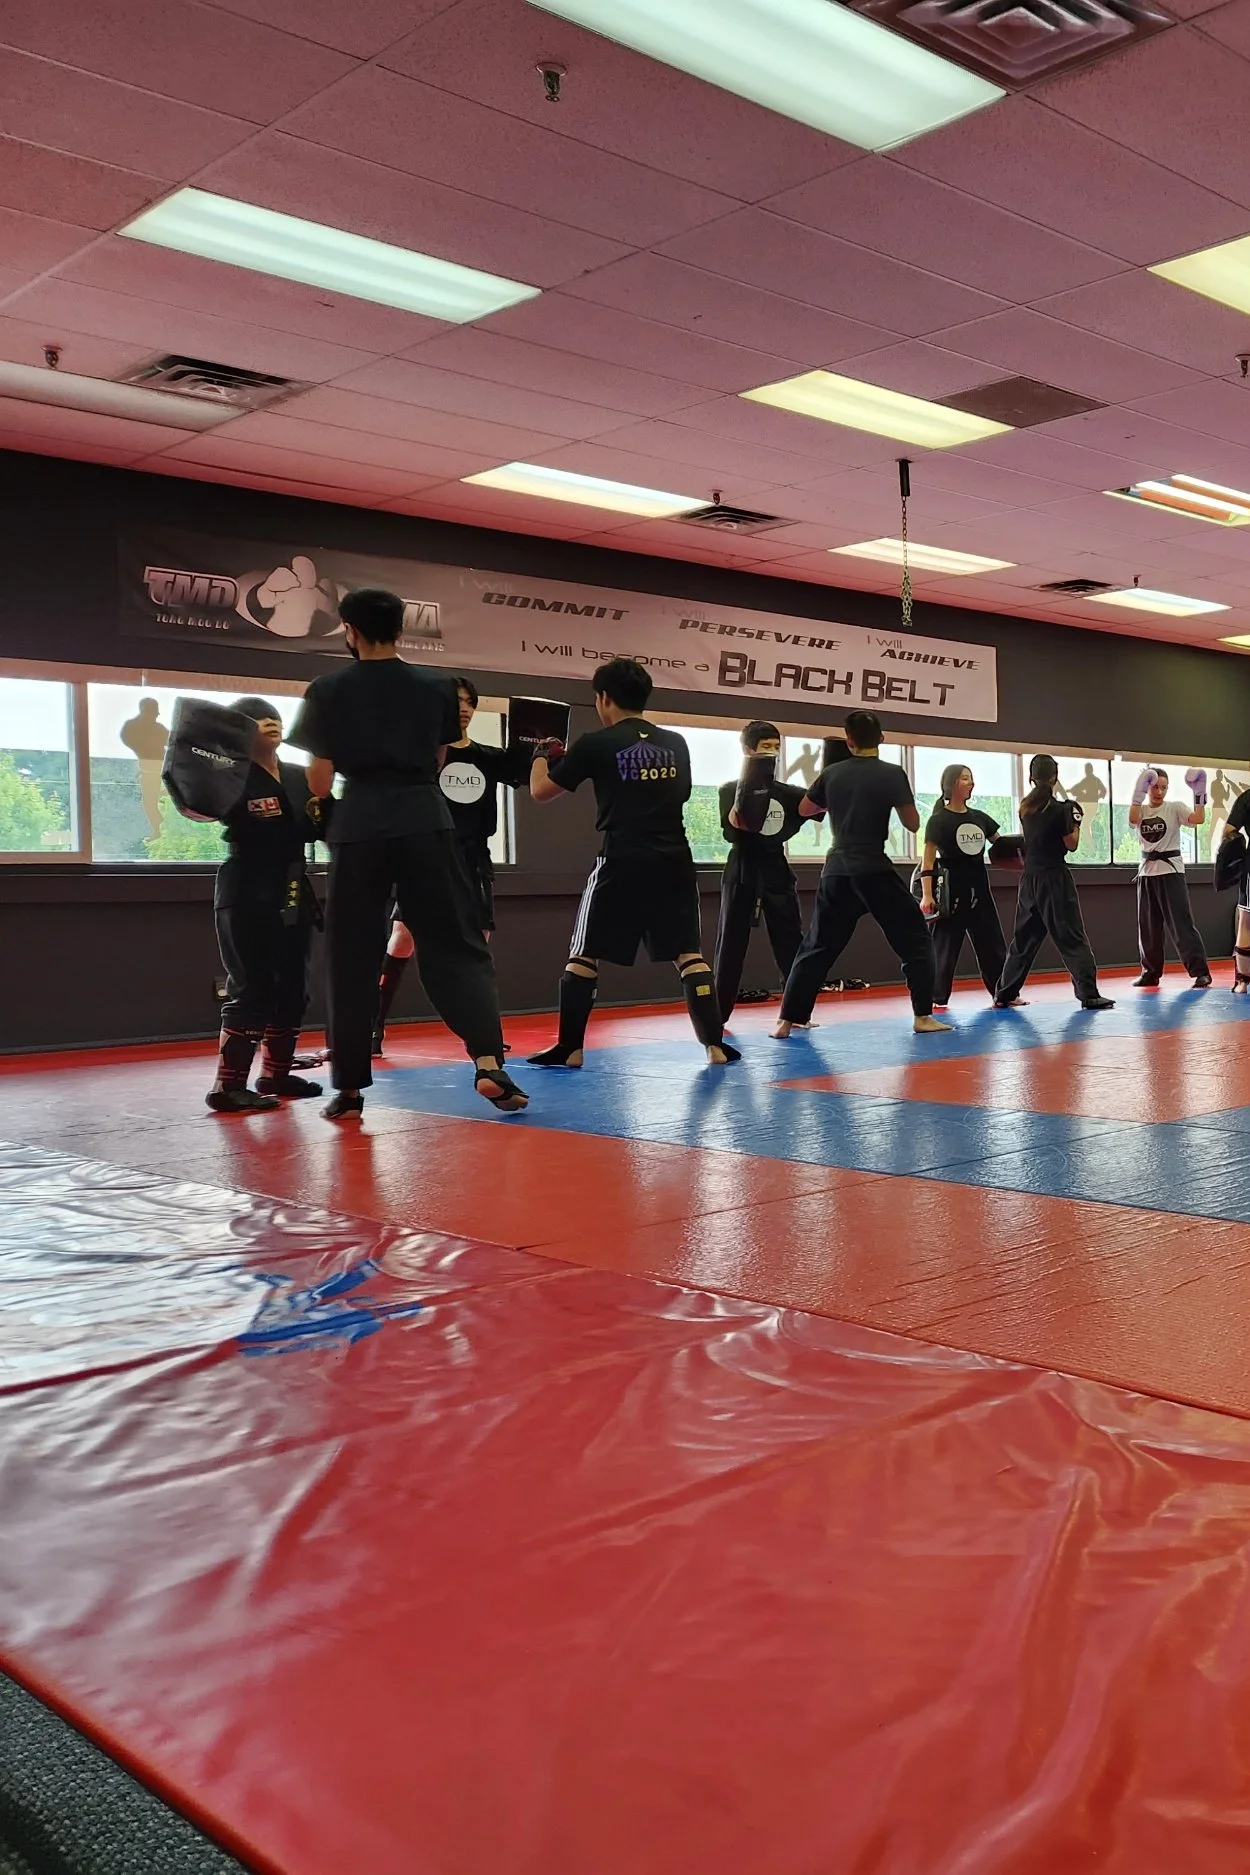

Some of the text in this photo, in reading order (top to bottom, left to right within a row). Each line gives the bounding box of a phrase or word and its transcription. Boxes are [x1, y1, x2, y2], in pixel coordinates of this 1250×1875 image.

[145, 567, 238, 607] TMD
[481, 592, 630, 621] COMMIT
[679, 618, 842, 651] PERSEVERE
[876, 637, 902, 649] will
[880, 649, 981, 671] ACHIEVE
[521, 640, 526, 652] I
[534, 644, 573, 656] will
[695, 663, 710, 672] a
[718, 650, 853, 695] BLACK
[861, 668, 955, 706] BELT
[191, 746, 237, 766] CENTURY
[445, 774, 481, 786] TMD
[960, 832, 982, 842] TMD
[1142, 823, 1165, 832] TMD
